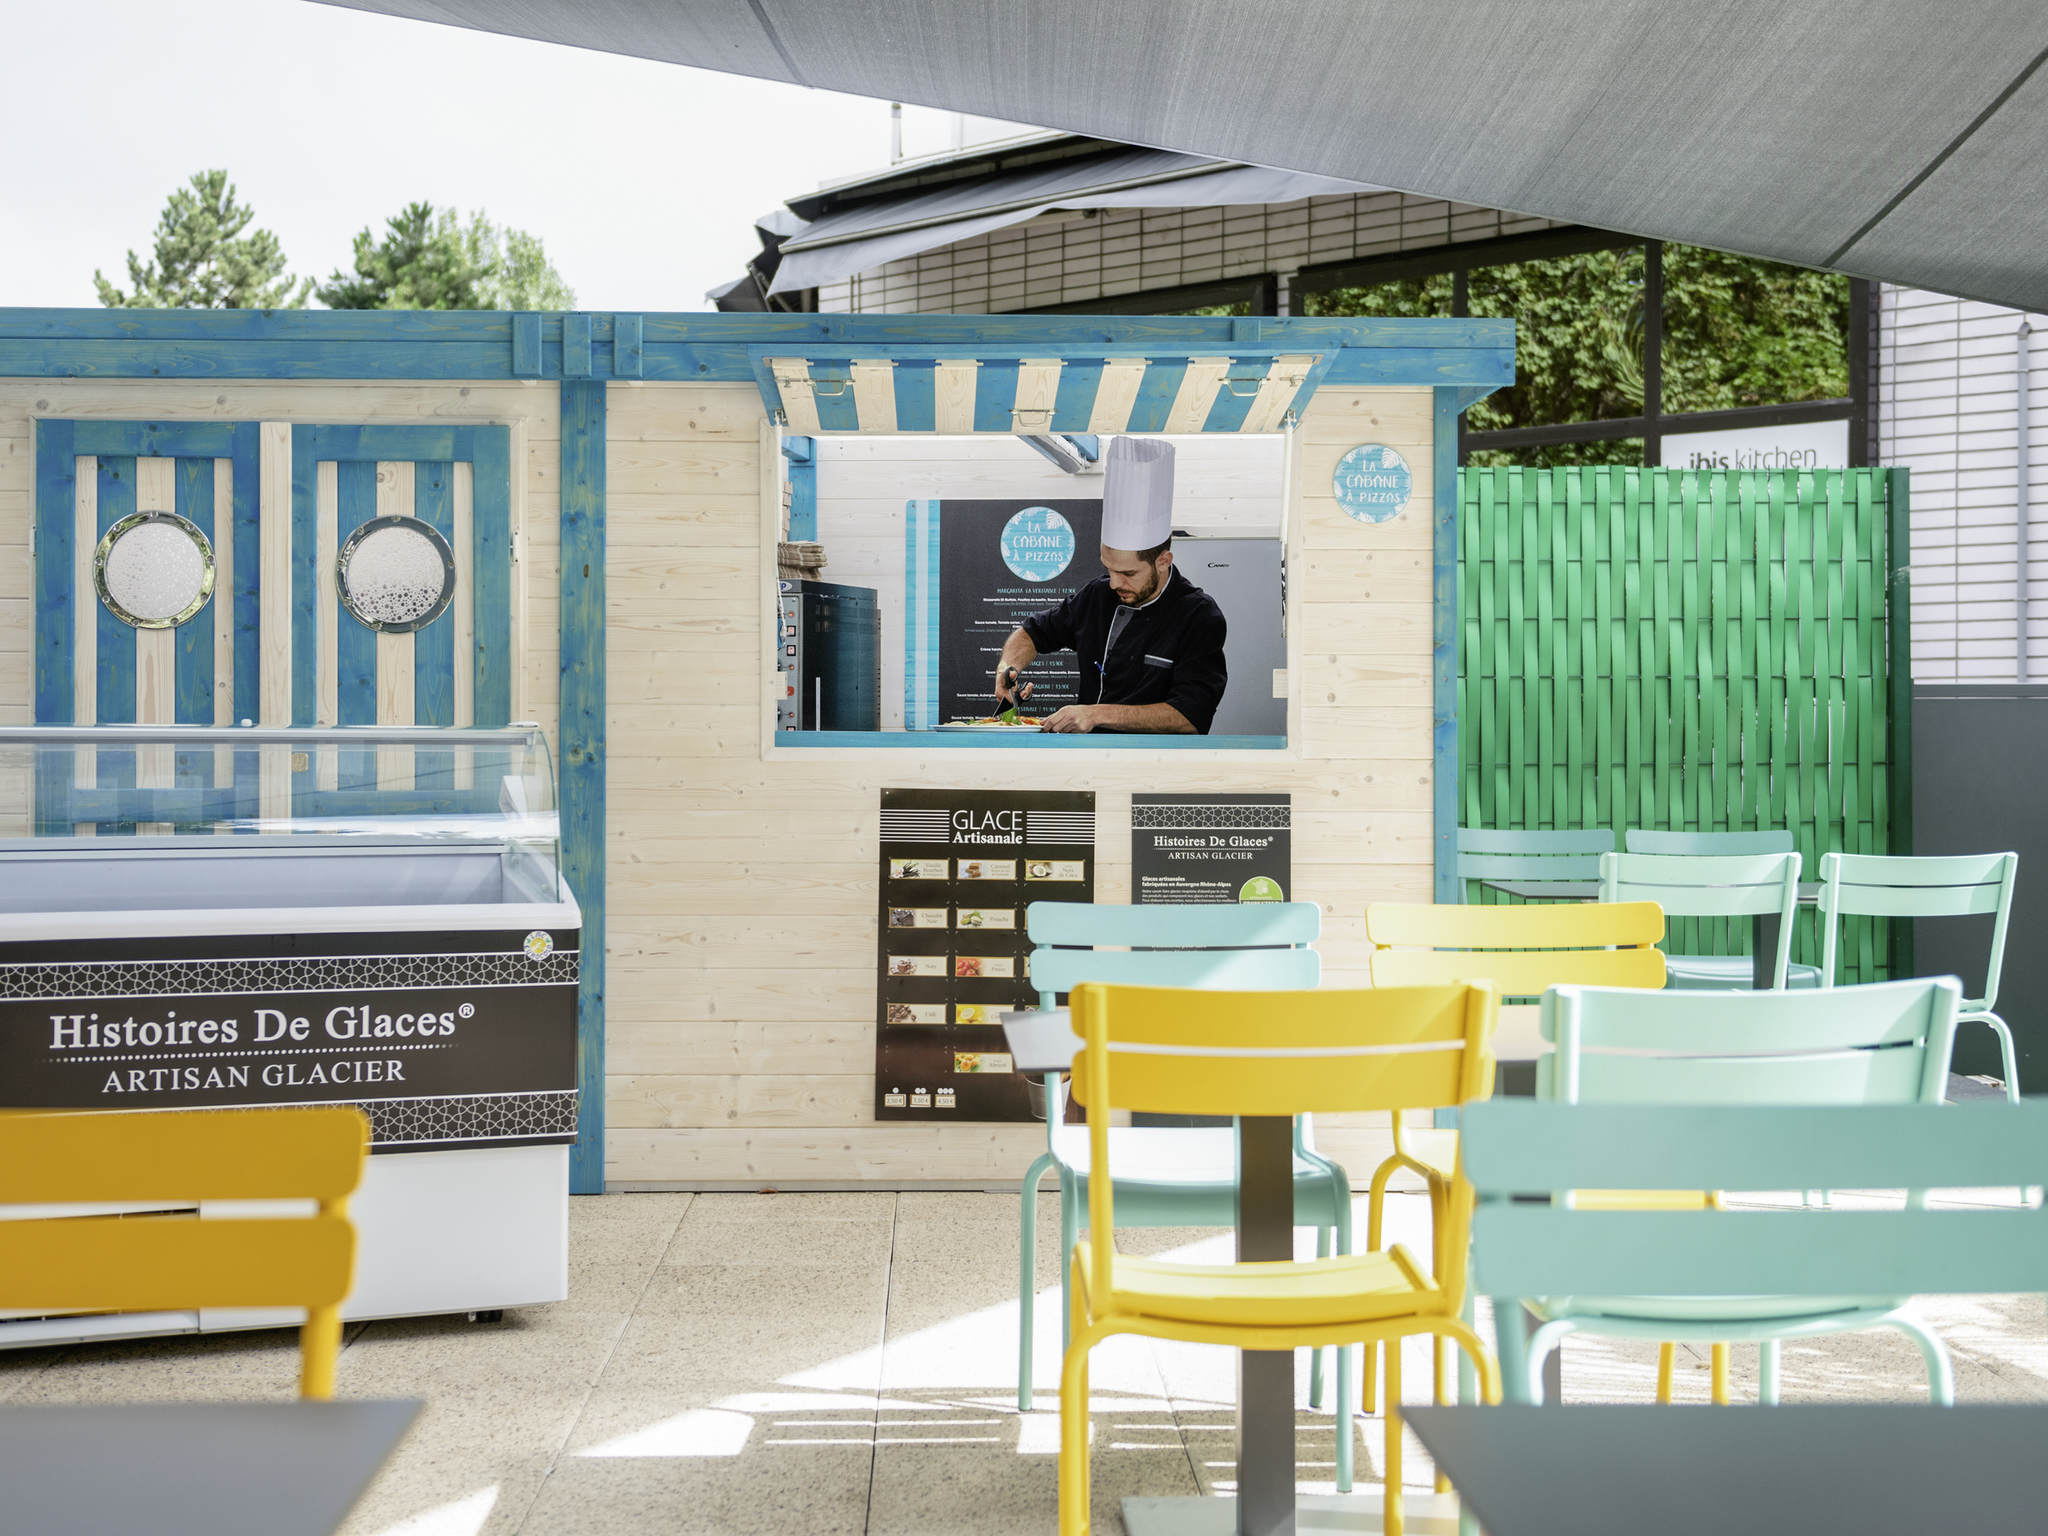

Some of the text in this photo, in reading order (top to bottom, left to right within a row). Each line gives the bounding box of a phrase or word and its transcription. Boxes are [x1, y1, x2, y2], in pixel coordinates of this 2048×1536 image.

[1735, 446, 1817, 469] kitchen
[1362, 460, 1376, 472] LA
[1346, 474, 1399, 488] CABANE
[1346, 489, 1400, 503] À PIZZAS
[1027, 520, 1040, 533] LA
[1013, 535, 1063, 548] CABANE
[1025, 551, 1063, 561] PIZZAS
[952, 809, 1023, 831] GLACE
[952, 831, 1023, 844] Artisanale
[1153, 835, 1206, 847] Histoires
[1209, 836, 1226, 847] De
[1168, 852, 1253, 860] ARTISAN GLACIER
[49, 1010, 238, 1049] Histoires
[253, 1009, 310, 1042] De
[101, 1059, 406, 1093] ARTISAN GLACIER
